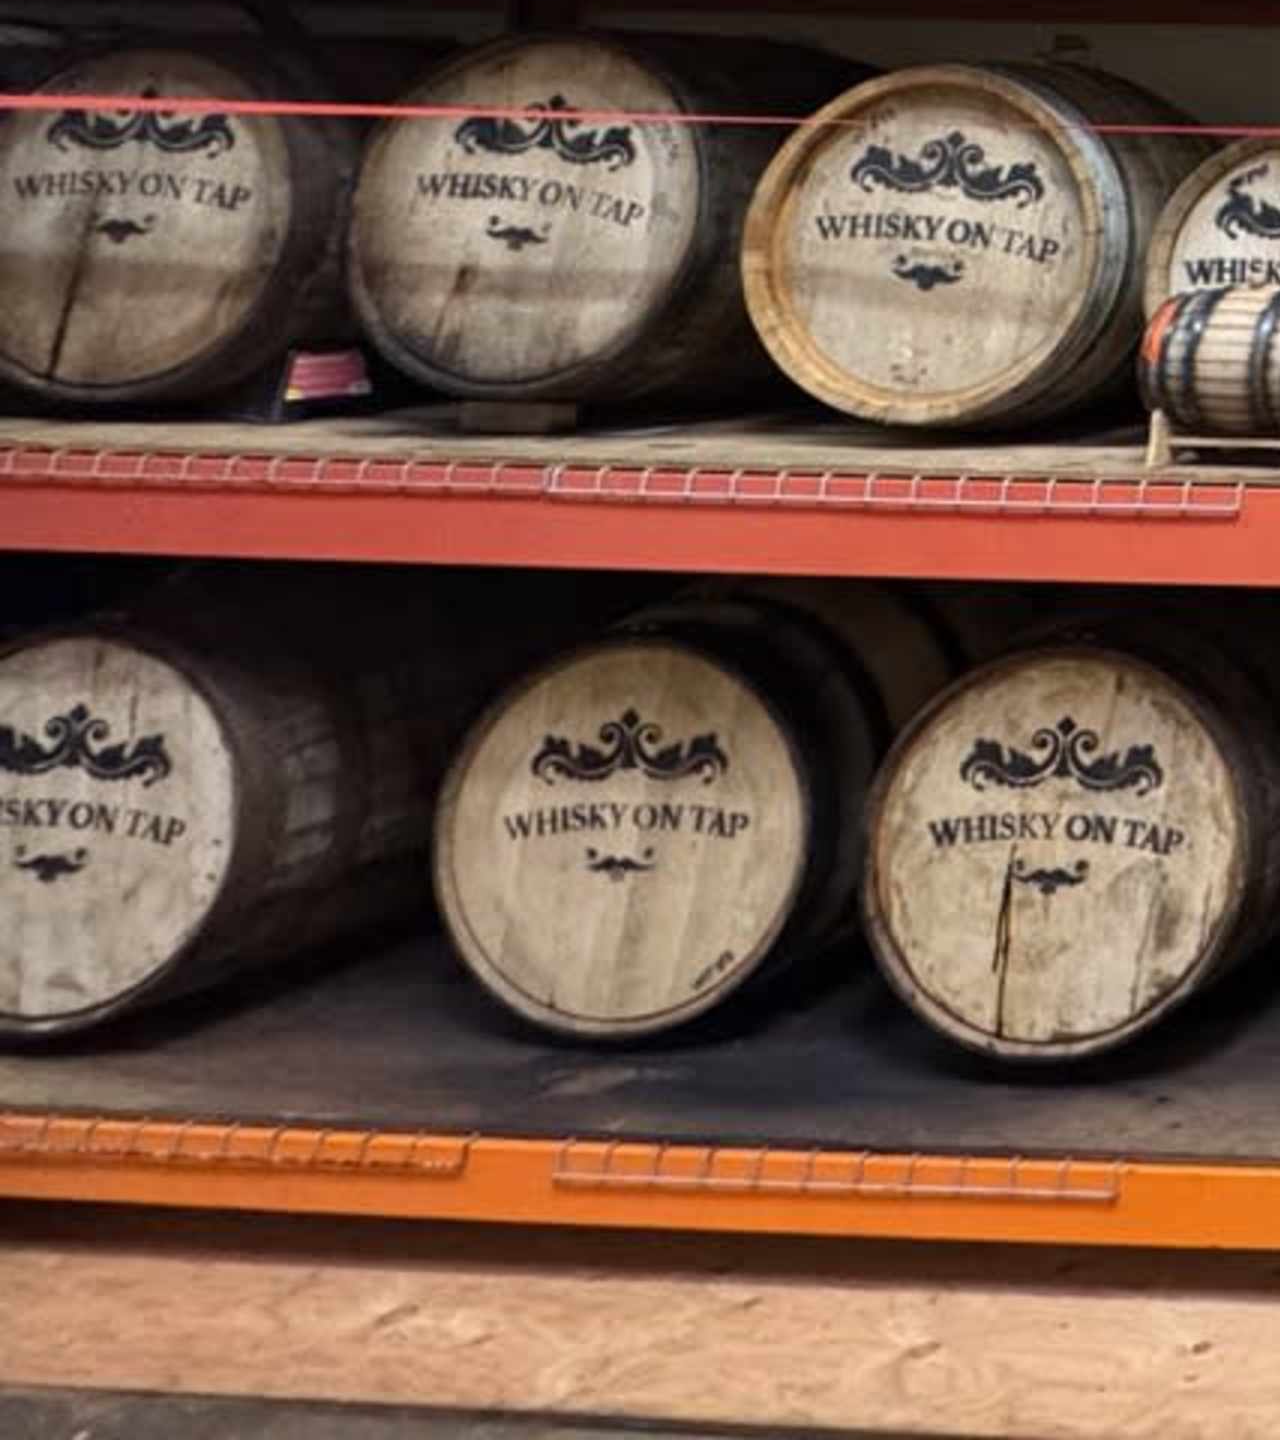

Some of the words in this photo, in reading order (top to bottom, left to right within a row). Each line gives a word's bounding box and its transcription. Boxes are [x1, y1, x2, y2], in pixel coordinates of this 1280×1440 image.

[14, 169, 137, 199] WHISKY
[140, 171, 189, 200] ON
[190, 178, 253, 210] TAP
[416, 173, 537, 202] WHISKY
[538, 181, 585, 211] ON
[588, 191, 645, 227] TAP
[816, 214, 946, 241] WHISKY
[947, 220, 998, 247] ON
[1000, 228, 1060, 262] TAP
[68, 803, 118, 835] ON
[120, 810, 187, 846] TAP
[503, 801, 628, 841] WHISKY
[633, 804, 682, 831] ON
[686, 806, 749, 839] TAP
[929, 811, 1060, 848] WHISKY
[1065, 816, 1120, 844] ON
[1125, 820, 1184, 855] TAP
